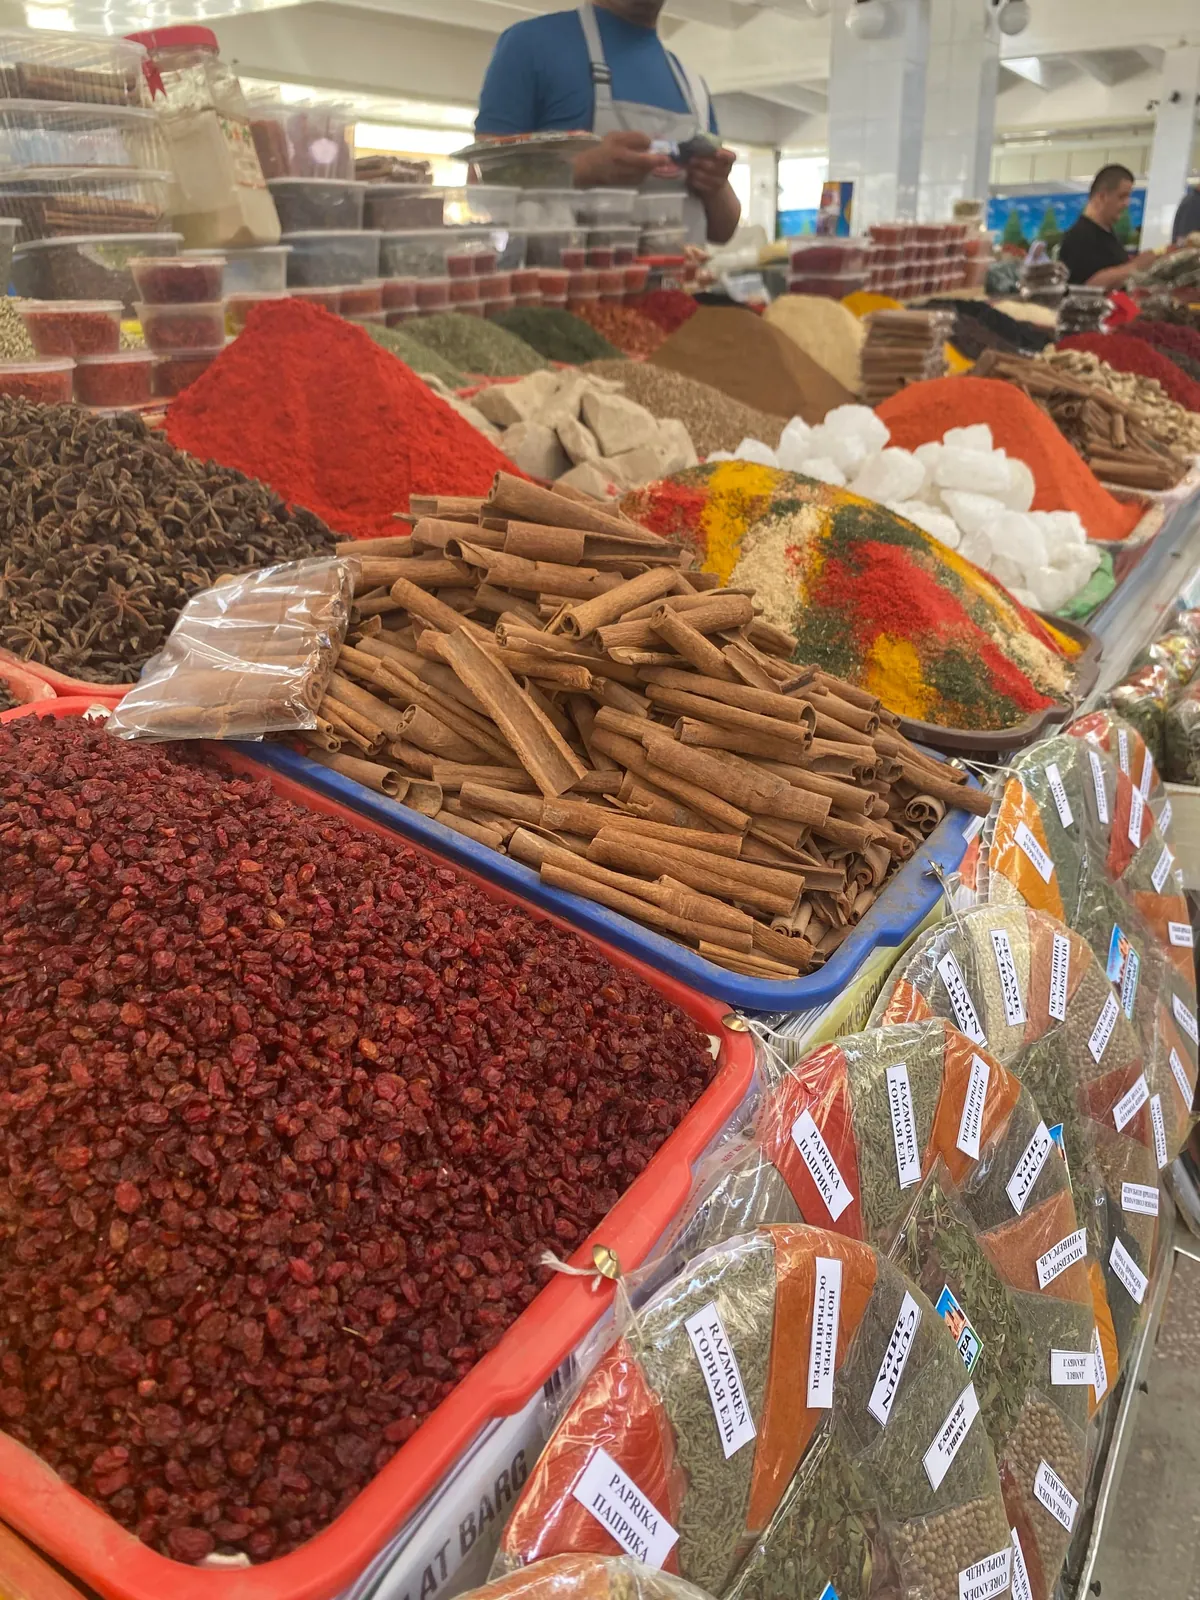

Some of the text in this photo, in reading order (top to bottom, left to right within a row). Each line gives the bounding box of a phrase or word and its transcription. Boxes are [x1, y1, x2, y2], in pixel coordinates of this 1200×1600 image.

[945, 976, 968, 1032] ЗИРА
[946, 961, 980, 1035] CUMIN
[1001, 938, 1020, 1015] SEZAME
[890, 1079, 908, 1171] ГОРНАЯ ЕЛЬ
[899, 1081, 916, 1163] RAZMOREN
[971, 1102, 981, 1139] PEPPER
[799, 1139, 833, 1204] ПАПРИКА
[810, 1131, 840, 1189] PAPRIKA
[1016, 1136, 1039, 1177] ЗИРА
[1017, 1139, 1047, 1200] CUMIN
[1040, 1232, 1082, 1266] УНИВЕРСАЛЬ
[1043, 1246, 1083, 1283] MIXEDSPICES
[812, 1275, 827, 1389] ОСТРЫЙ ПЕРЕЦ
[823, 1290, 835, 1376] HOT PEPPER
[879, 1313, 906, 1382] ЗИРА
[882, 1310, 915, 1412] CUMIN
[693, 1326, 735, 1444] ГОРНАЯ ЕЛЬ
[709, 1322, 748, 1427] RAZMOREN
[938, 1400, 965, 1452] ДЖАМБУЛ
[945, 1418, 967, 1456] JAMBUL
[464, 1449, 528, 1557] BARG
[592, 1492, 649, 1563] ПАПРИКА
[609, 1473, 658, 1536] PAPRIKA
[966, 1554, 1006, 1581] КОРЕАНДЬ
